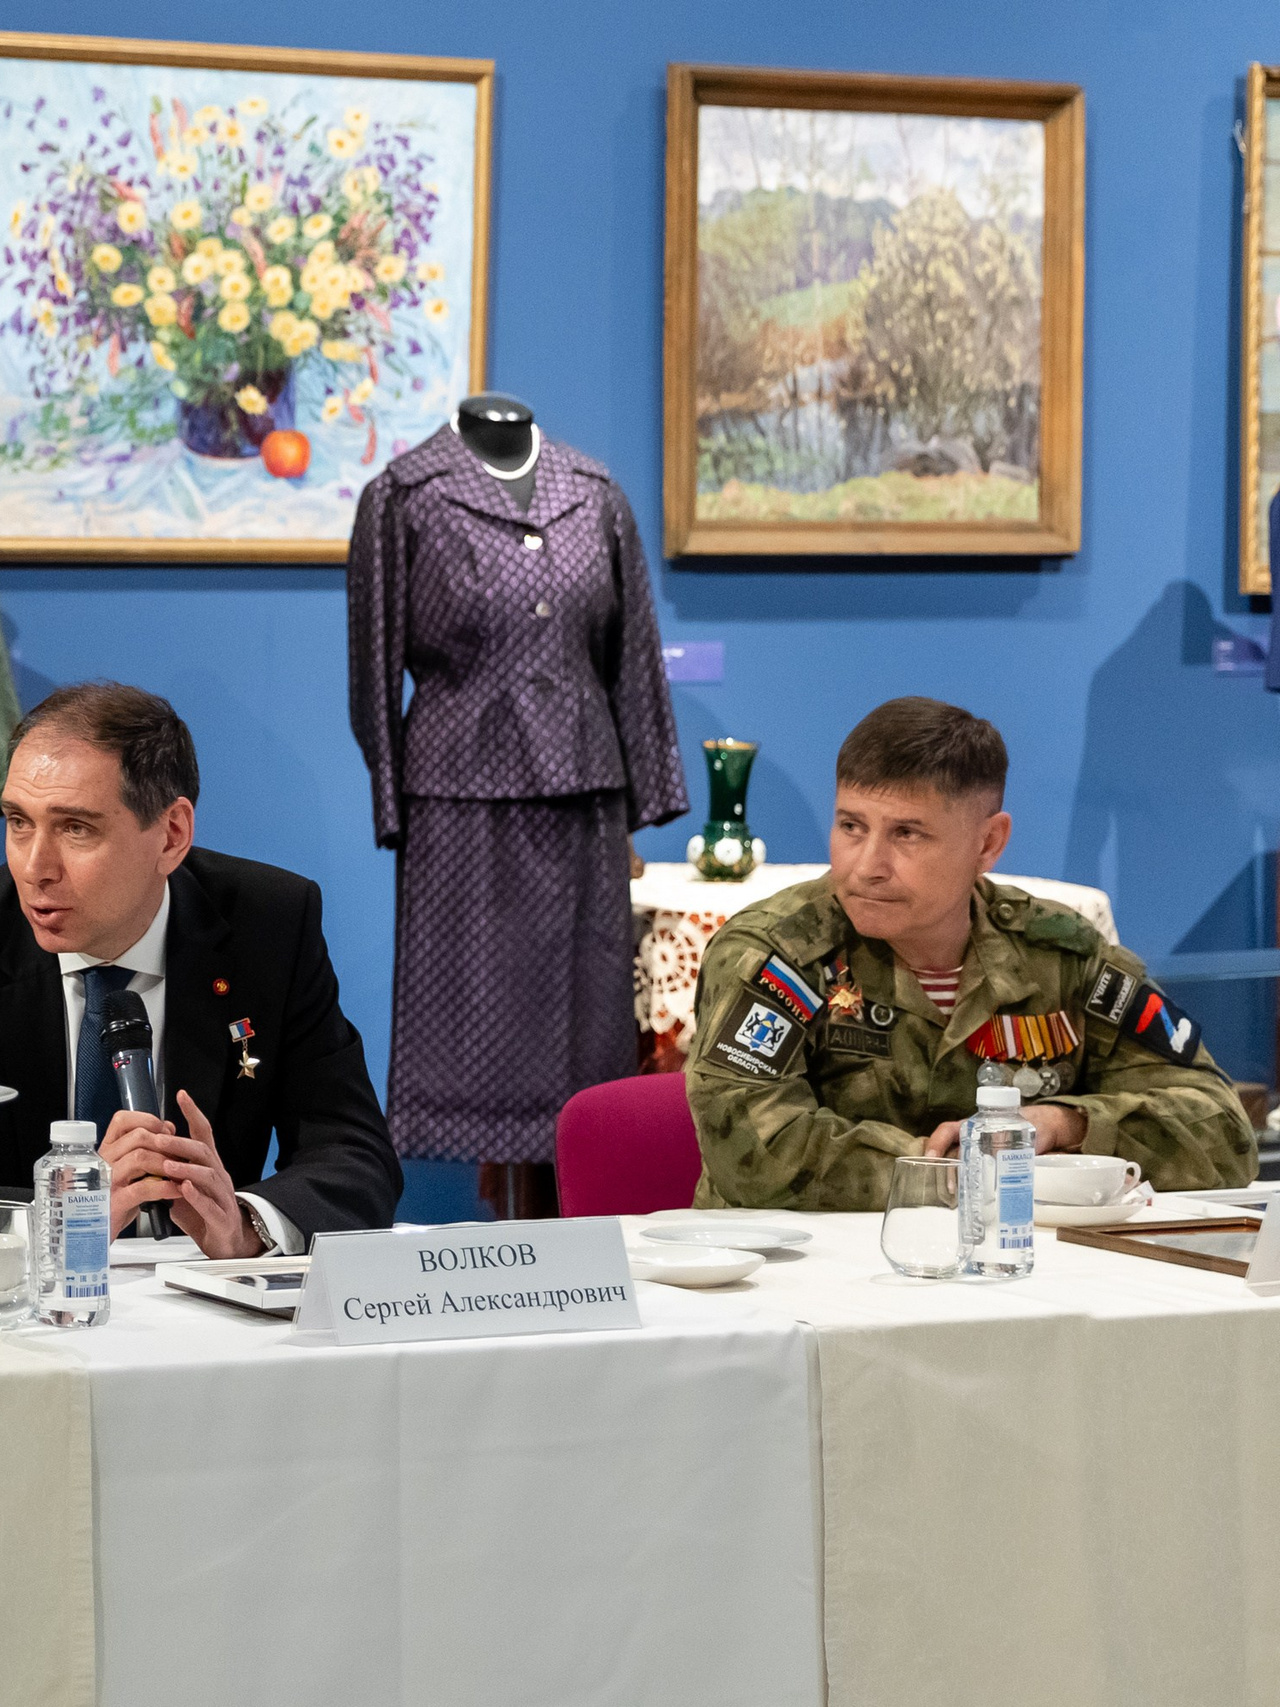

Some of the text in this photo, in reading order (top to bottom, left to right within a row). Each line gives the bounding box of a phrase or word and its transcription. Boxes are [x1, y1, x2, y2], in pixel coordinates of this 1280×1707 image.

[716, 1042, 777, 1075] НОВОСИБИРСКАЯ
[727, 1055, 759, 1074] ОБЛАСТЬ
[418, 1243, 537, 1272] ВОЛКОВ
[343, 1285, 627, 1324] Сергей Александрович
